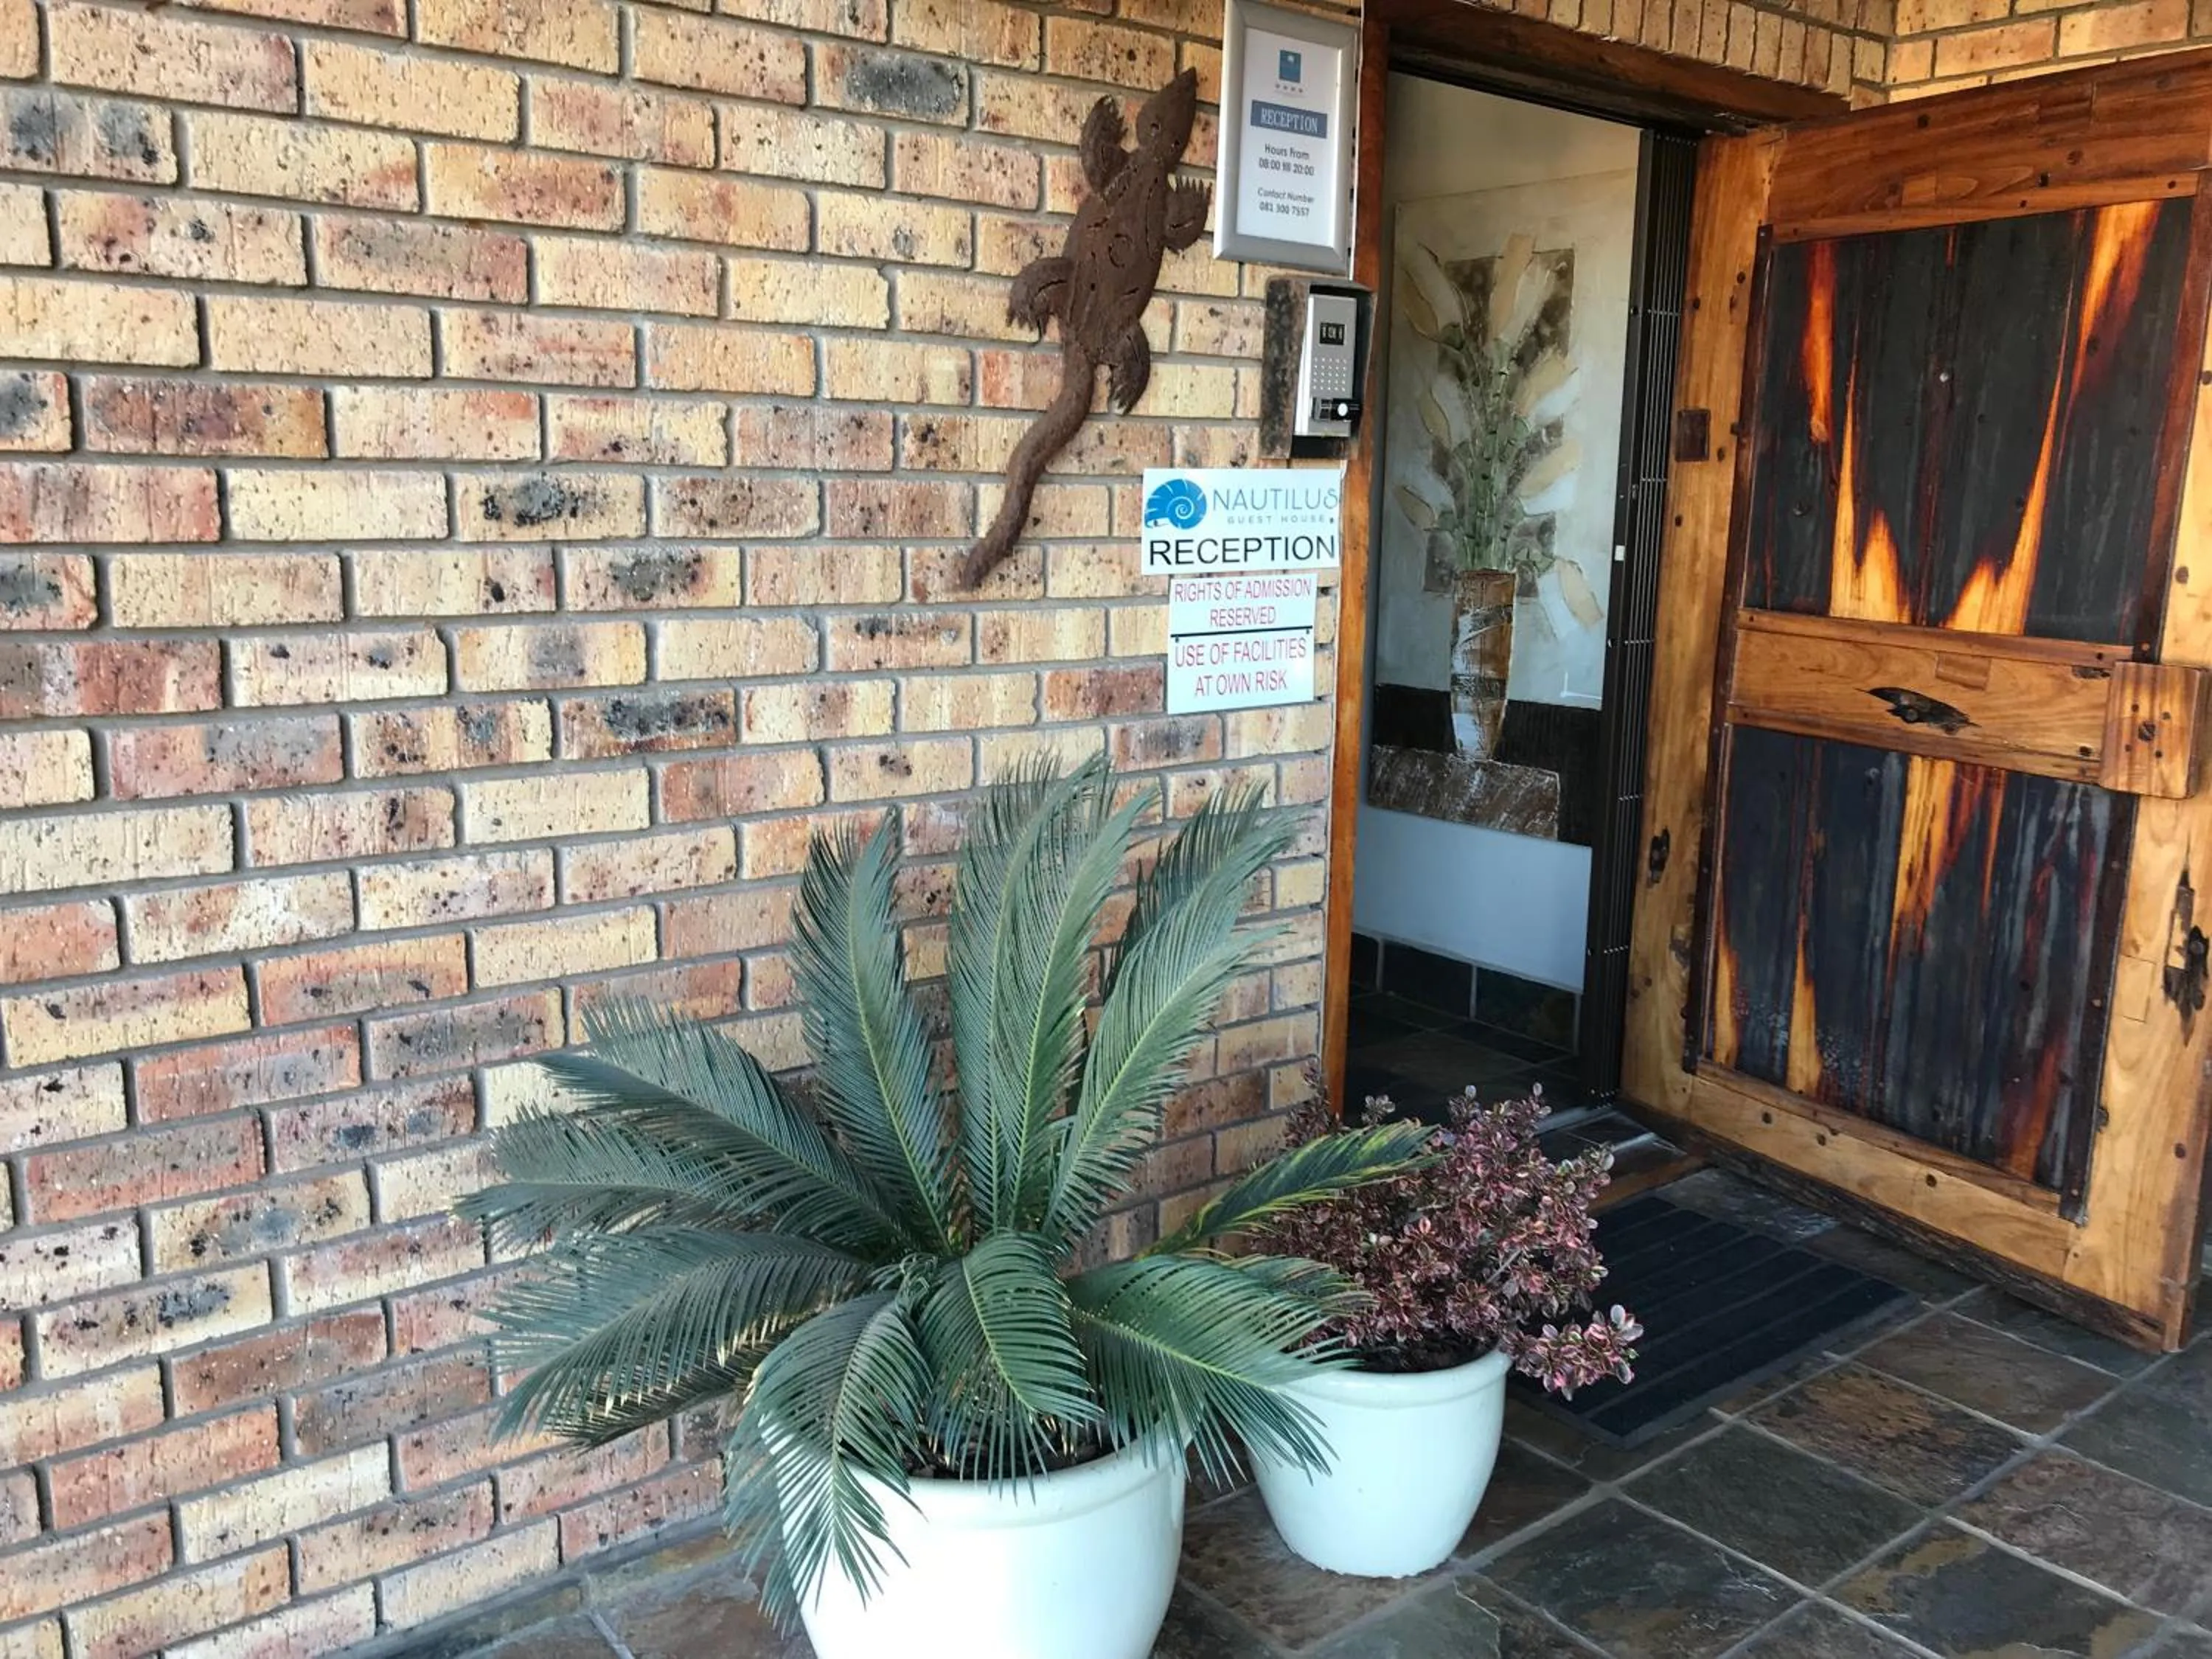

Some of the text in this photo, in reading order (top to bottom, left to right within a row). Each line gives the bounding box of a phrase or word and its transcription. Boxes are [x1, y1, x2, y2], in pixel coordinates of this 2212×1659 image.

[1260, 107, 1318, 134] RECEPTION
[1265, 143, 1287, 157] Hours
[1259, 157, 1280, 170] 08:00
[1293, 163, 1315, 176] 20:00
[1257, 187, 1315, 203] Contact Number
[1212, 488, 1338, 510] NAUTILUS
[1227, 514, 1325, 524] GUEST HOUSE
[1150, 535, 1335, 566] RECEPTION
[1175, 578, 1312, 602] RIGHTS OF ADMISSION
[1209, 605, 1276, 627] RESERVED
[1175, 637, 1307, 667] USE OF FACILITIES
[1194, 669, 1288, 697] AT OWN RISK
